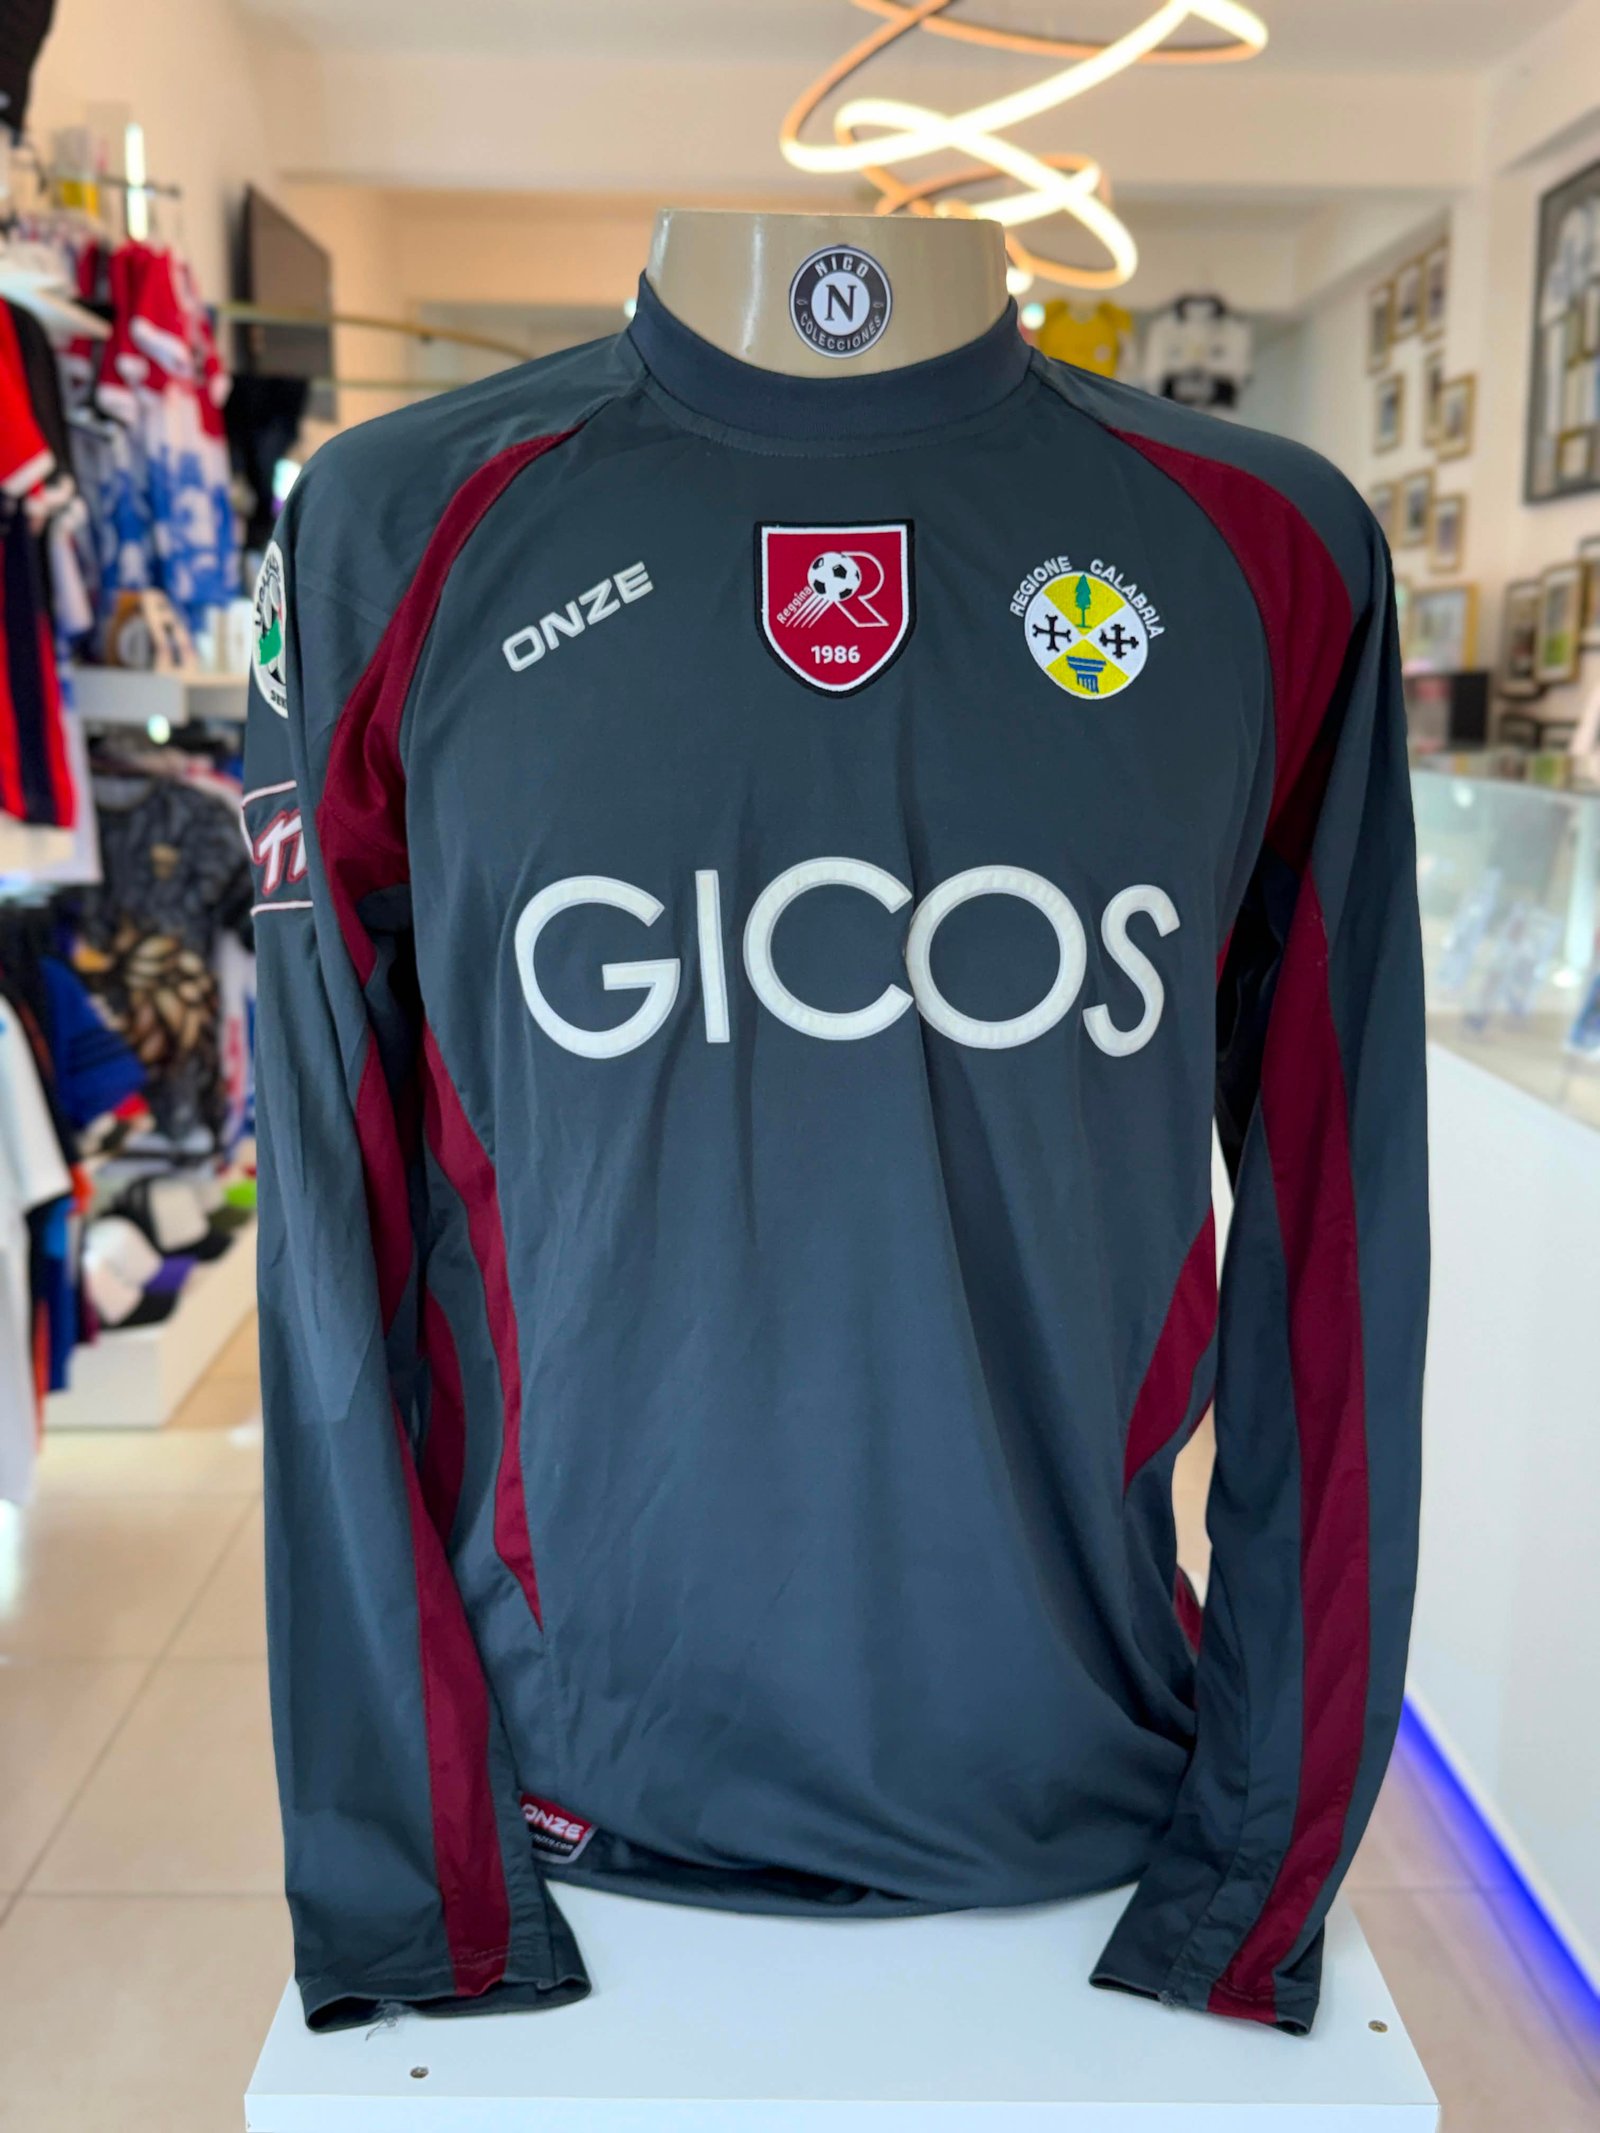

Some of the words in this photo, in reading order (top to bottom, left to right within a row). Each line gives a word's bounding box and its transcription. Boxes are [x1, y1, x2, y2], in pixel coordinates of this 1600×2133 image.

[814, 255, 869, 278] NICO
[824, 283, 858, 322] N
[800, 312, 882, 351] COLECCIONES
[502, 560, 654, 672] ONZE
[776, 585, 813, 625] Reggina
[1009, 555, 1072, 618] REGIONE
[1090, 558, 1165, 639] CALABRIA
[811, 645, 861, 664] 1986
[514, 856, 1181, 1059] GICOS
[522, 1803, 584, 1841] ONZE
